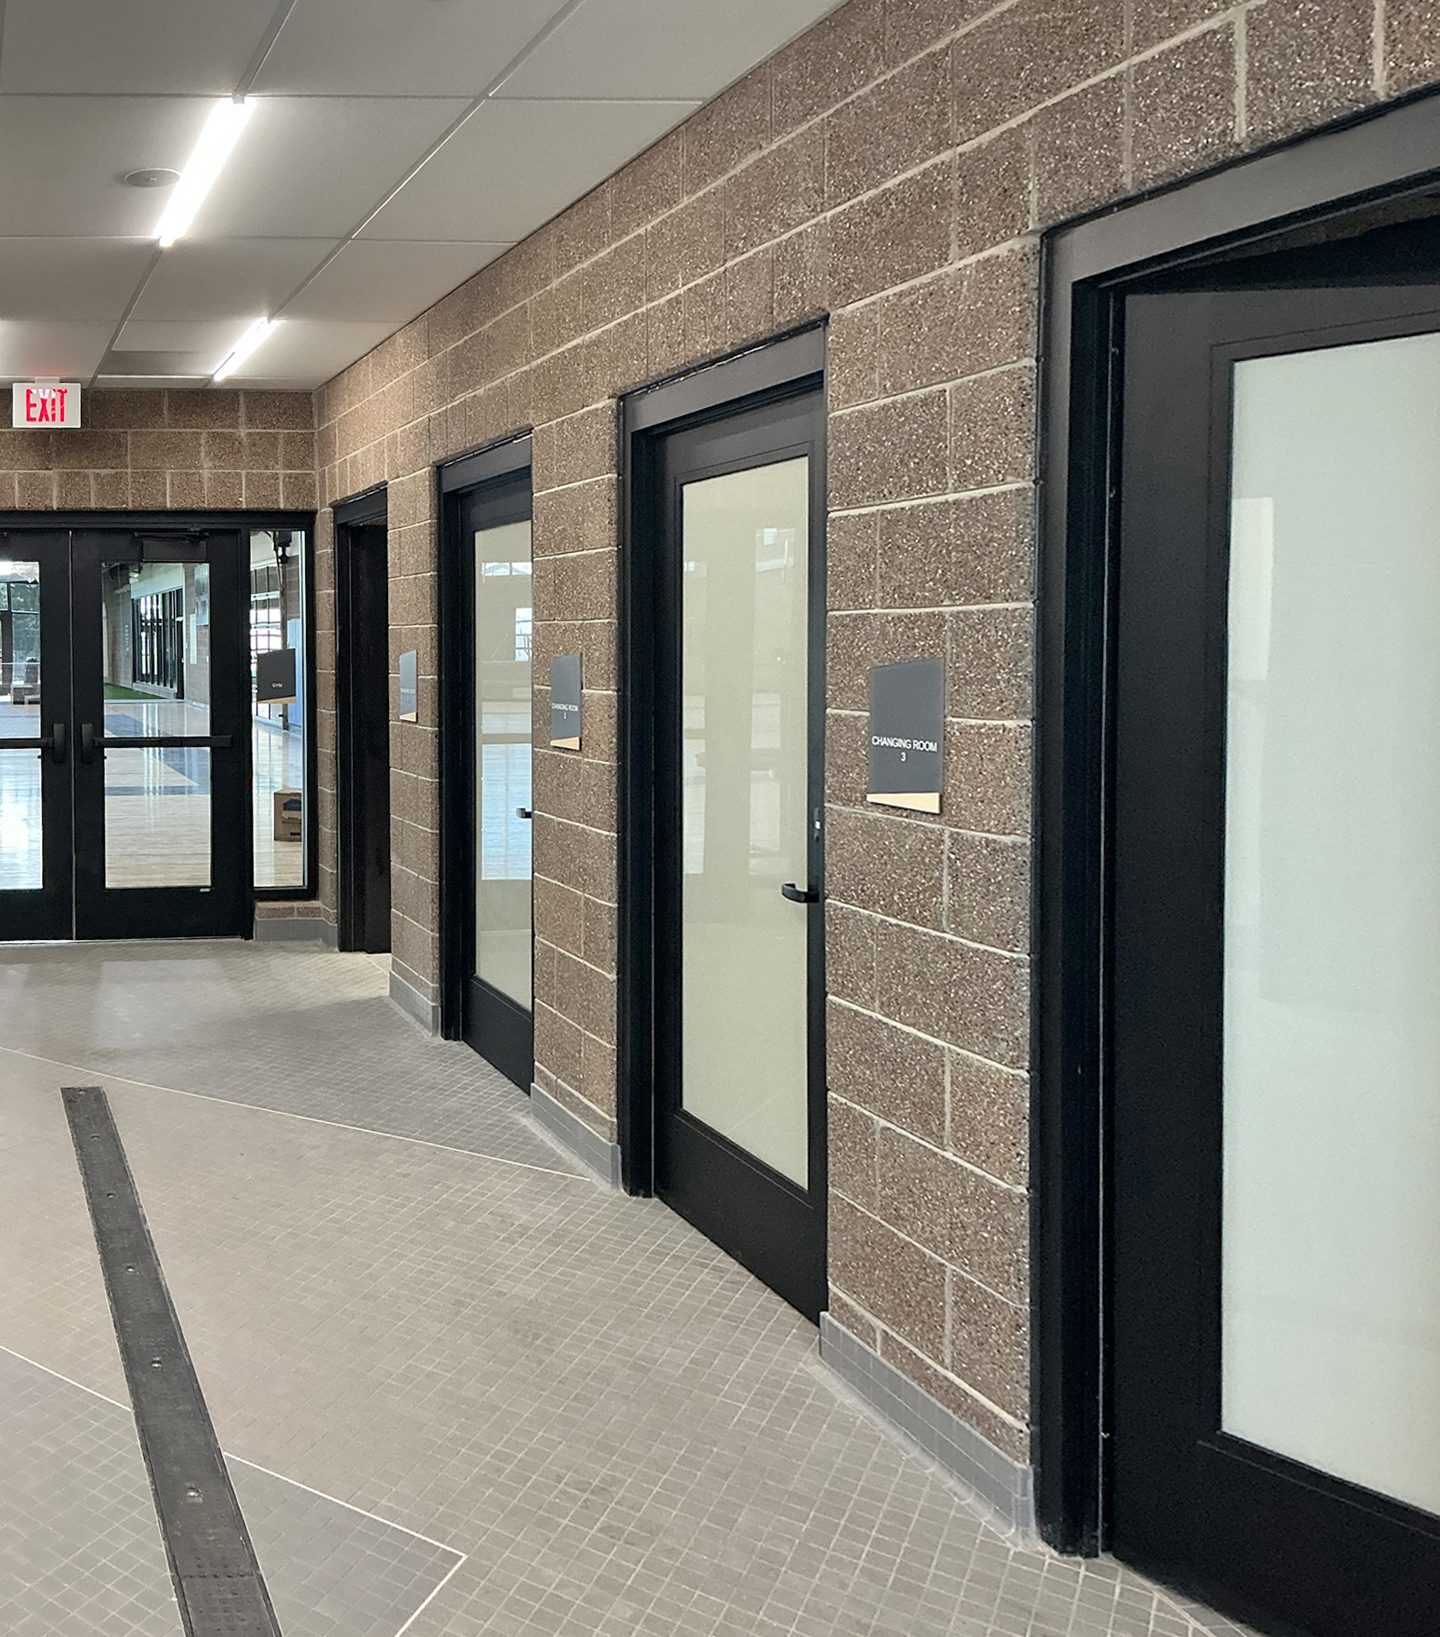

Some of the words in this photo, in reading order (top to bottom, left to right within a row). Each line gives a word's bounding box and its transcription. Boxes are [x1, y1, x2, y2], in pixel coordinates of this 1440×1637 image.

[26, 388, 68, 422] EXIT
[872, 736, 911, 749] CHANGING
[913, 740, 937, 752] ROOM
[900, 752, 906, 761] 3
